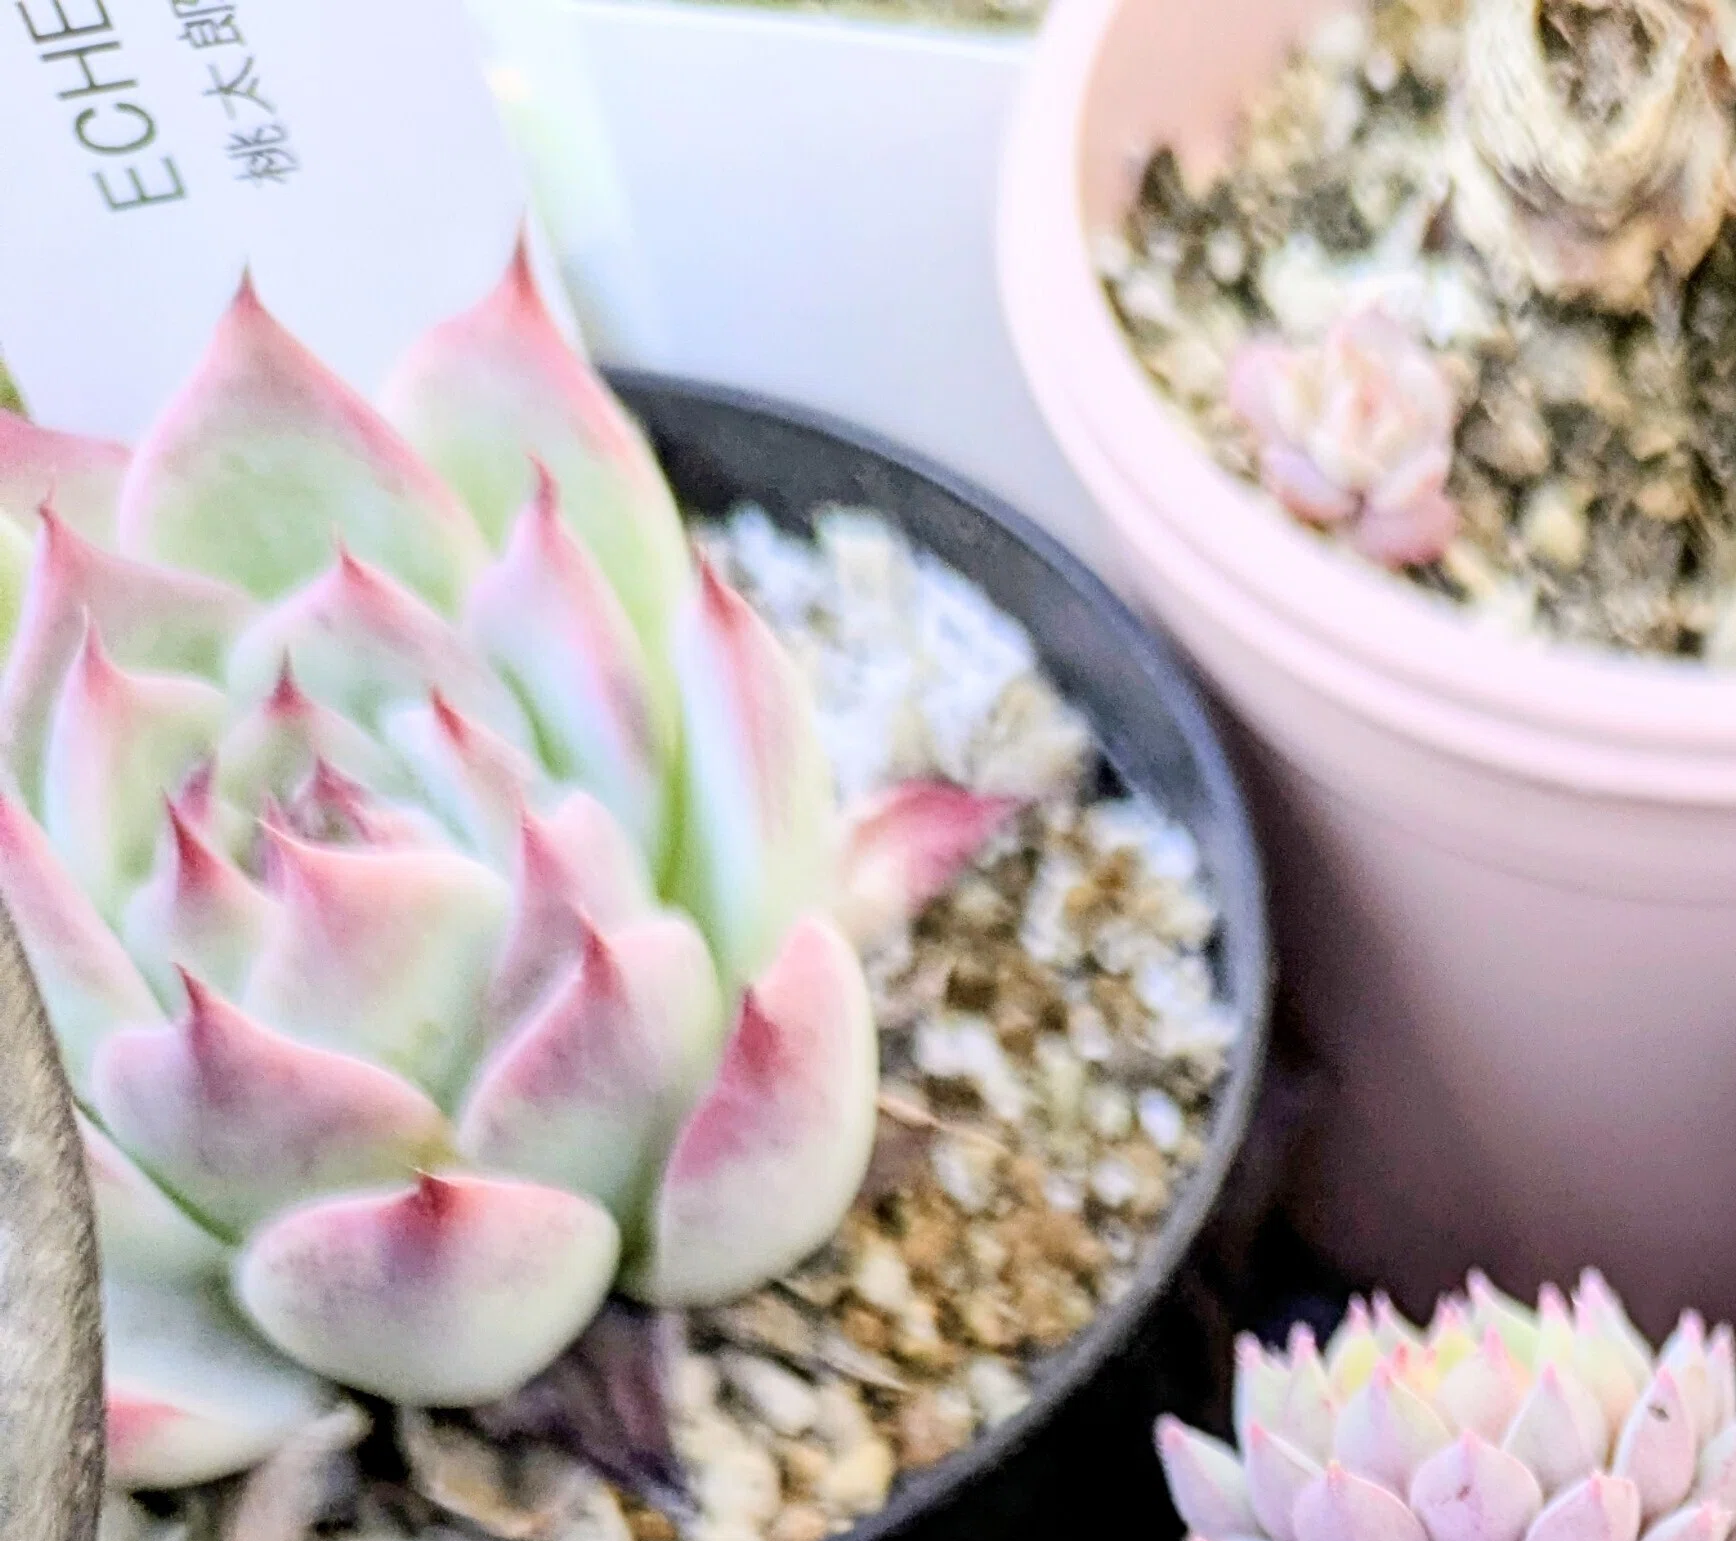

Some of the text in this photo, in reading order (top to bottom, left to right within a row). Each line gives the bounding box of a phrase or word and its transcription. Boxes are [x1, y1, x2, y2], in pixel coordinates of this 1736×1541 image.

[17, 0, 187, 211] ECHE
[173, 0, 300, 186] 桃太郎
